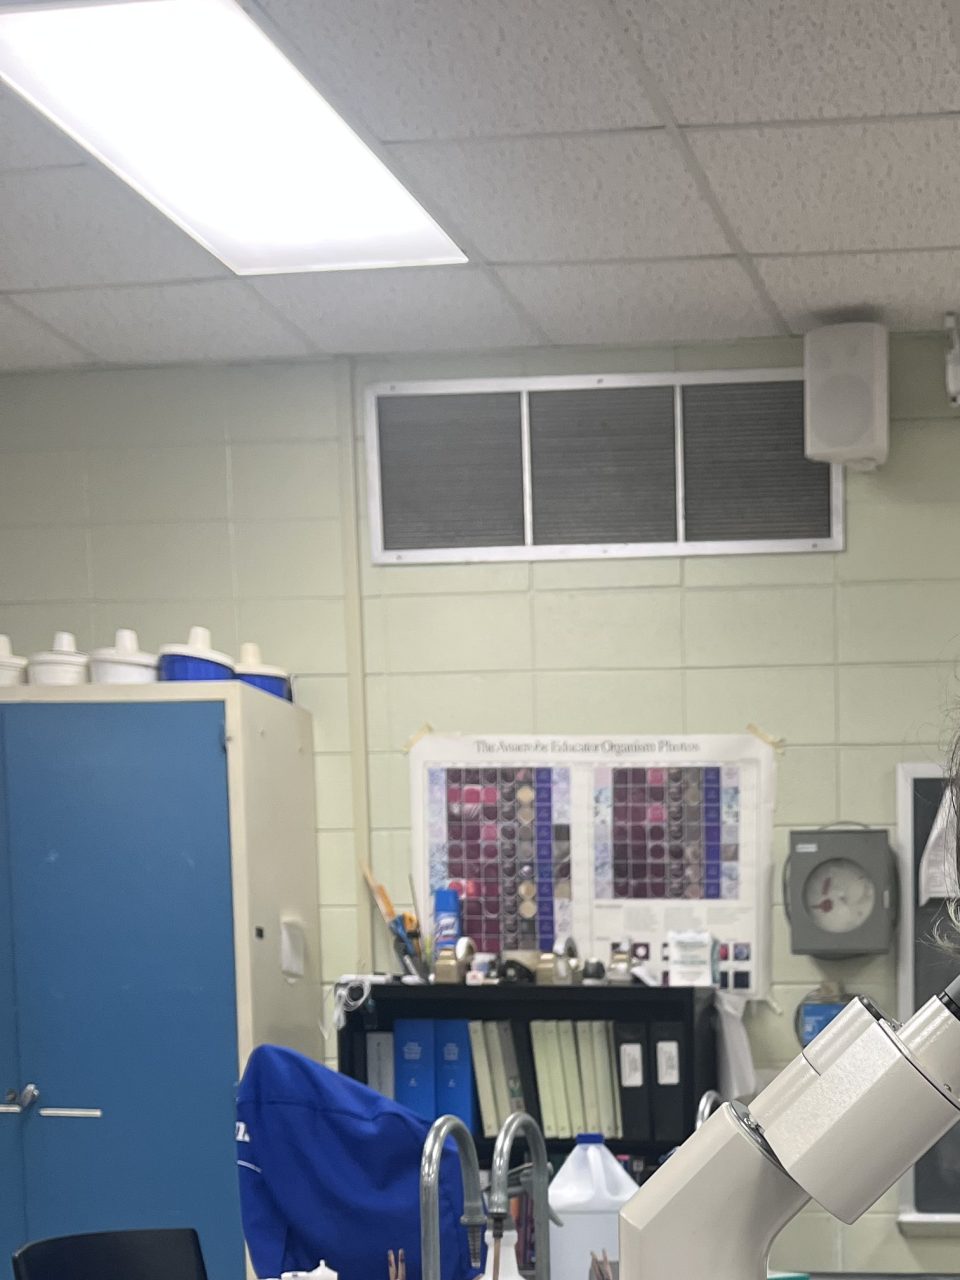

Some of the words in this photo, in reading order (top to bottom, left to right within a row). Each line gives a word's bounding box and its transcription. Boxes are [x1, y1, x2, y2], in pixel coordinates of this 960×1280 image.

[474, 740, 495, 753] The
[550, 740, 600, 753] Educator
[600, 740, 656, 756] Organism
[658, 740, 701, 753] Photos
